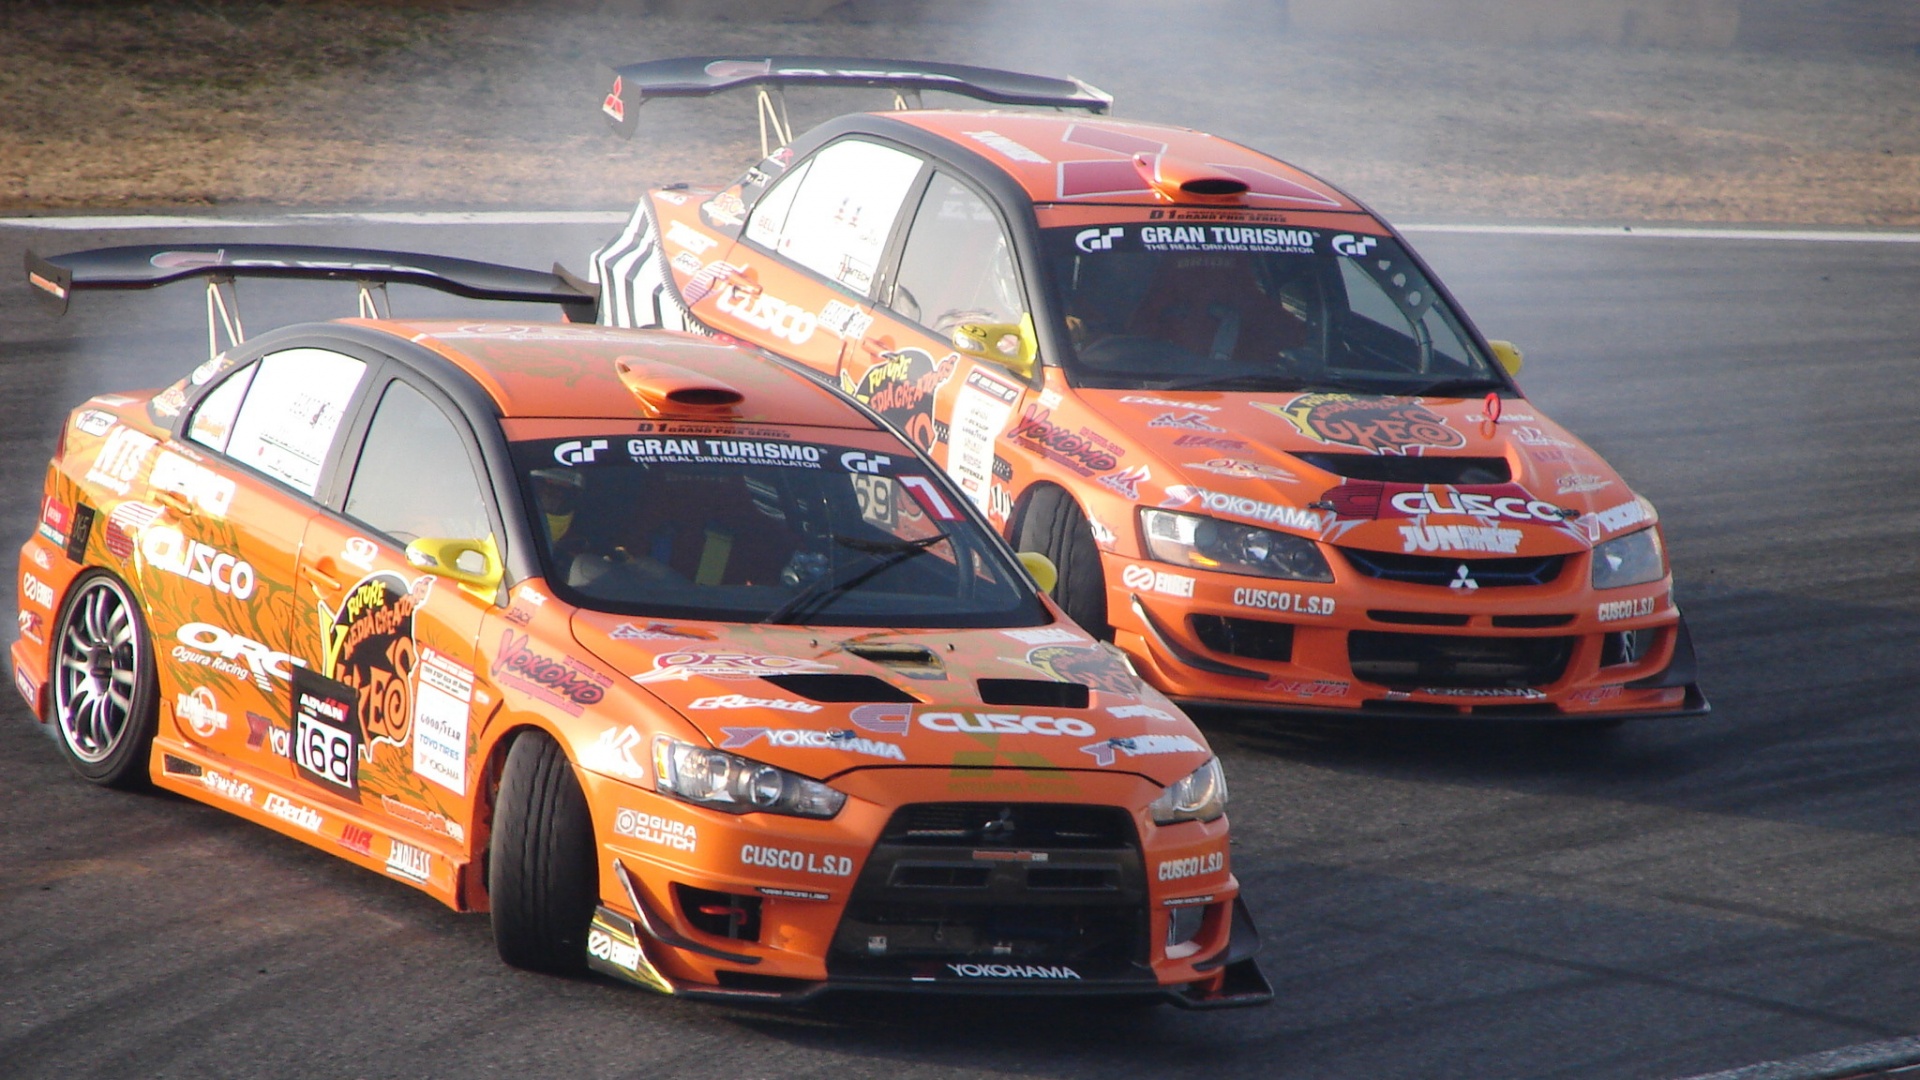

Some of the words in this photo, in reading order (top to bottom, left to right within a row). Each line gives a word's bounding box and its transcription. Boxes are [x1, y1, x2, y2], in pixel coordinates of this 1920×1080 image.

[1141, 226, 1213, 245] GRAN
[1215, 227, 1313, 246] TURISMO
[1250, 245, 1314, 254] SIMULATOR
[627, 438, 699, 457] GRAN
[705, 440, 821, 462] TURISMO
[1007, 403, 1117, 471] YOKOMO
[631, 455, 656, 463] THE
[659, 456, 694, 464] REAL
[696, 456, 747, 465] DRIVING
[748, 457, 822, 469] SIMULATOR
[1200, 491, 1323, 532] YOKOHAMA
[1391, 491, 1564, 523] CUSCO
[347, 579, 387, 623] FUTURE
[1233, 587, 1290, 611] CUSCO
[1294, 594, 1336, 615] L.S.D
[1598, 601, 1631, 622] CUSCO
[343, 608, 375, 661] MEDIA
[171, 645, 211, 667] Ogura
[211, 657, 249, 681] Racing
[176, 621, 308, 681] ORC
[657, 654, 796, 671] ORC
[491, 628, 605, 705] YOKOMO
[299, 692, 346, 722] ADVAN
[687, 694, 823, 714] GReddy
[420, 713, 462, 741] GOODYEAR
[917, 711, 1097, 738] CUSCO
[299, 720, 349, 782] 168
[420, 733, 438, 751] TOYO
[438, 742, 460, 761] TIRES
[203, 769, 255, 804] Swift
[262, 791, 323, 832] GReddy
[636, 811, 697, 839] OGURA
[634, 827, 696, 853] CLUTCH
[741, 843, 804, 872] CUSCO
[807, 856, 853, 877] L.S.D
[1158, 856, 1199, 881] CUSCO
[1200, 851, 1224, 875] L.S.D
[946, 963, 1081, 981] YOKOHAMA
